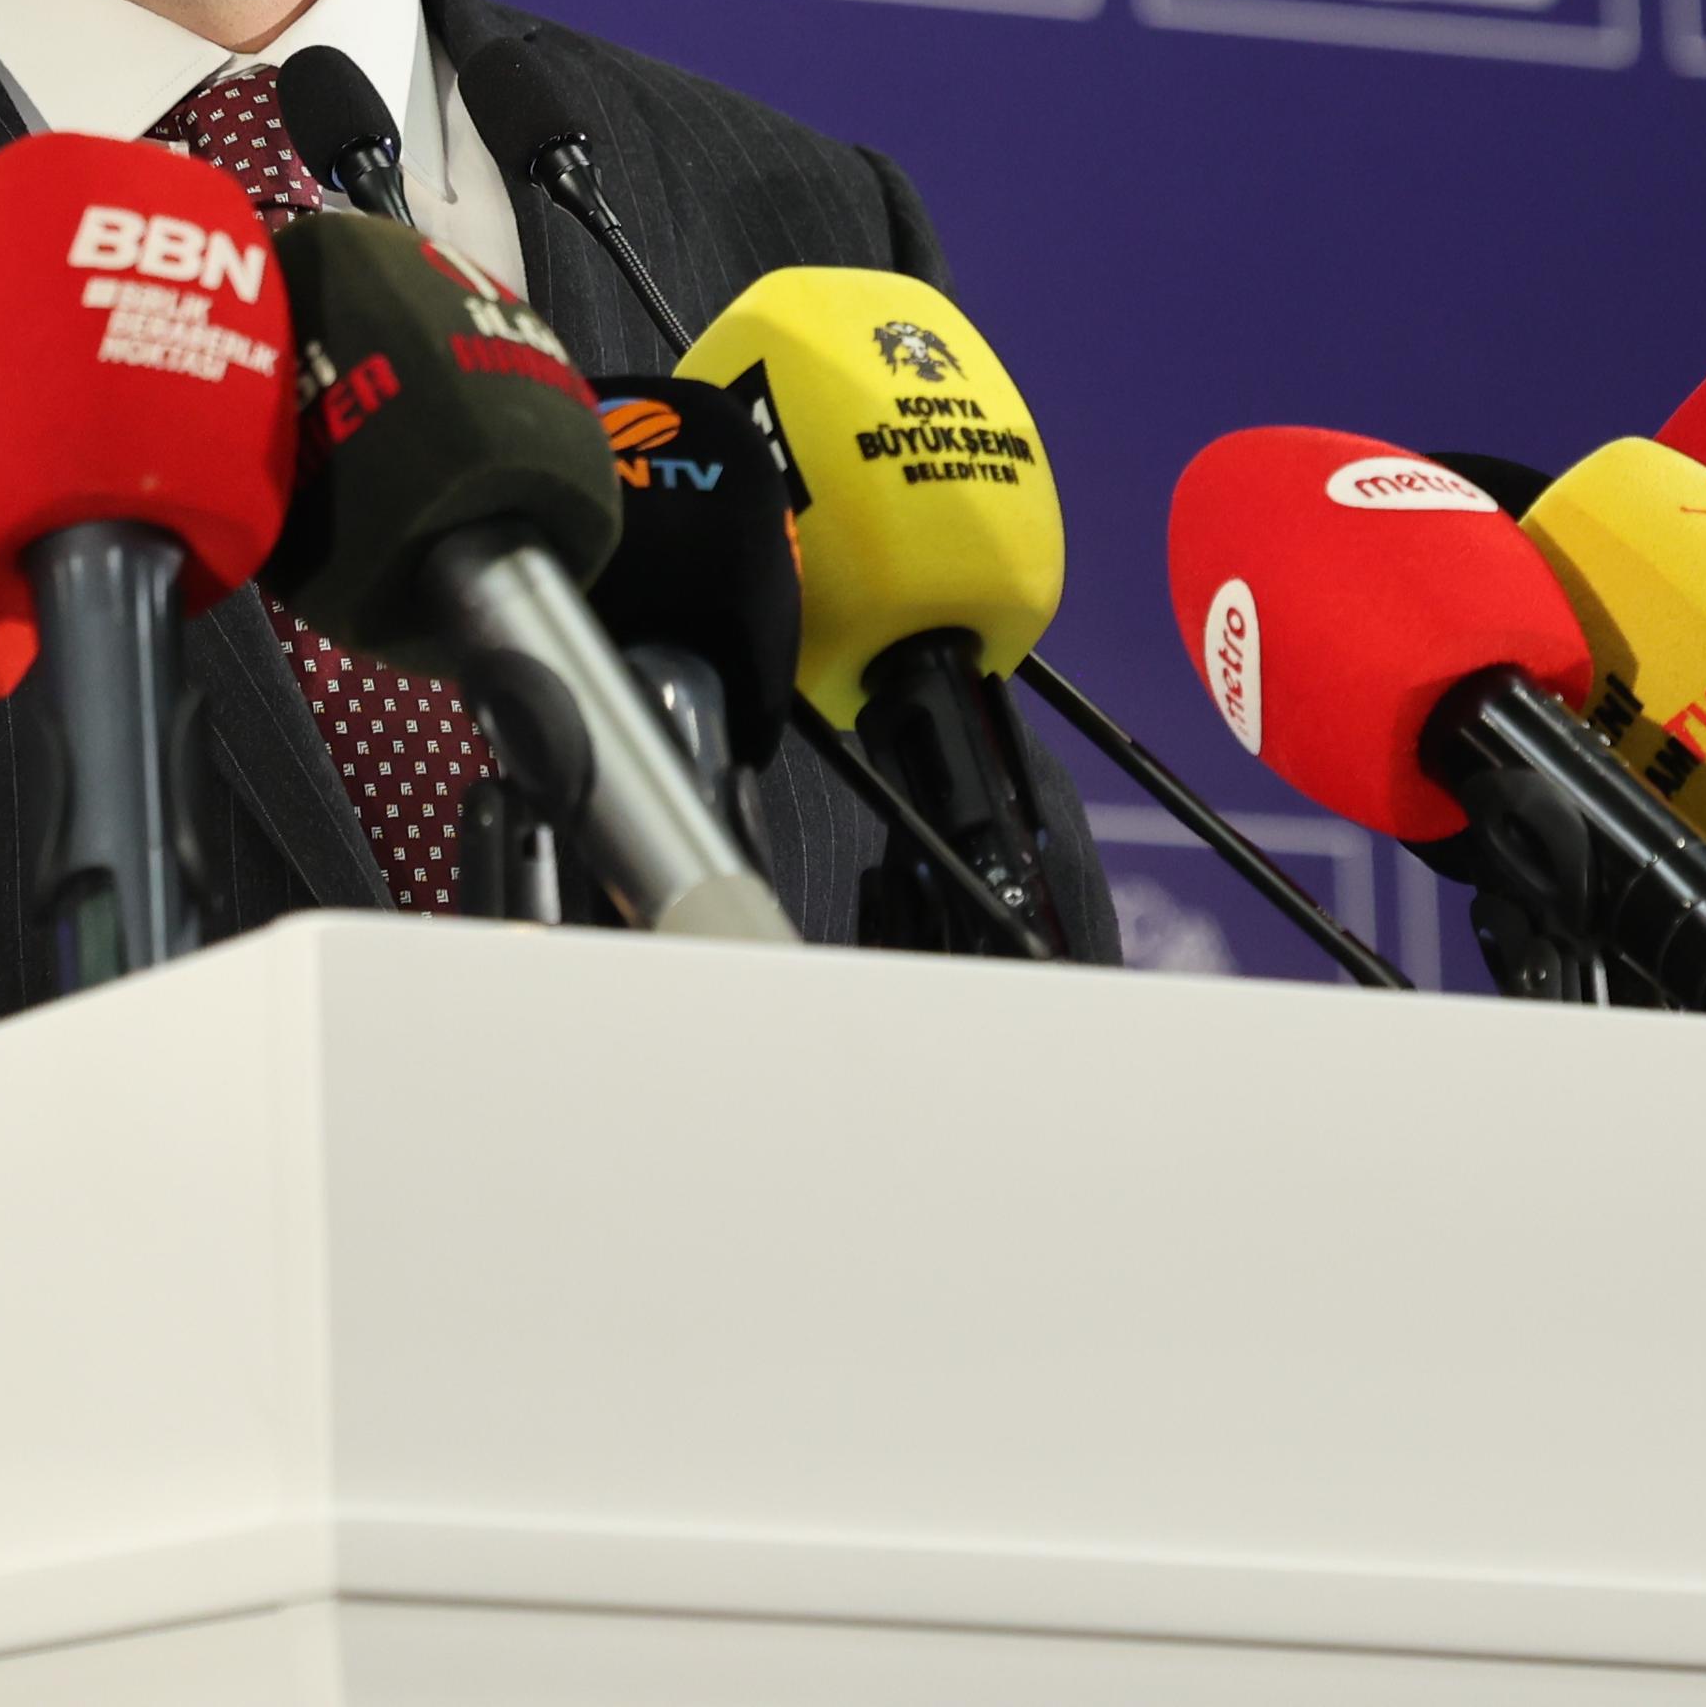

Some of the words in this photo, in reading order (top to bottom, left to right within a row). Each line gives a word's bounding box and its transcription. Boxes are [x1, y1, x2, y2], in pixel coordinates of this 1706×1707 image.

[66, 204, 267, 305] BBN
[855, 418, 1036, 466] BÜYÜKŞEHİR
[895, 396, 988, 421] KONYA
[1218, 607, 1249, 737] metro
